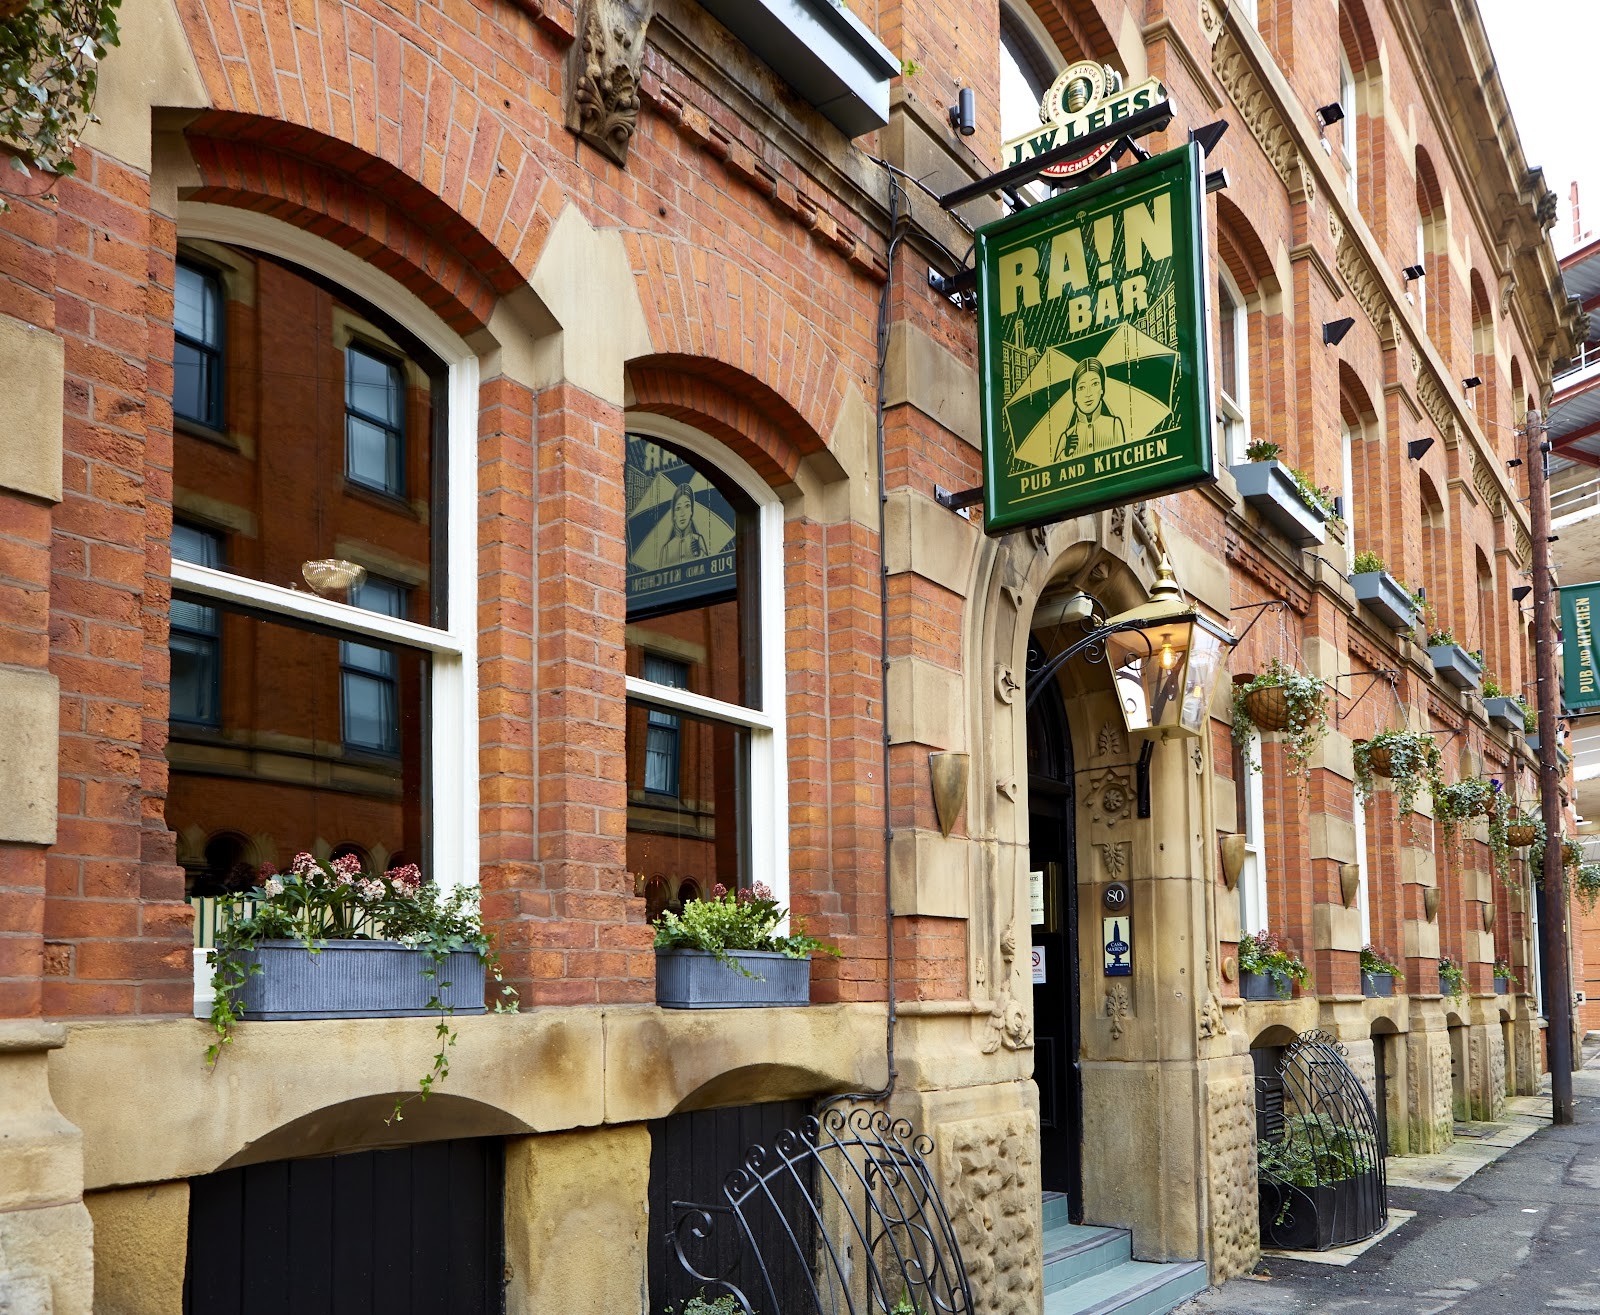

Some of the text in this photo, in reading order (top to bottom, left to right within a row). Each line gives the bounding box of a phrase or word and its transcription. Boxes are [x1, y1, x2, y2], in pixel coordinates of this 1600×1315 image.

[1074, 67, 1097, 79] SINCE
[1068, 275, 1149, 333] BAR
[1020, 438, 1168, 493] PUB AND KITCHEN
[1576, 597, 1594, 694] PUB AND KITCHEN
[1106, 889, 1124, 903] 80
